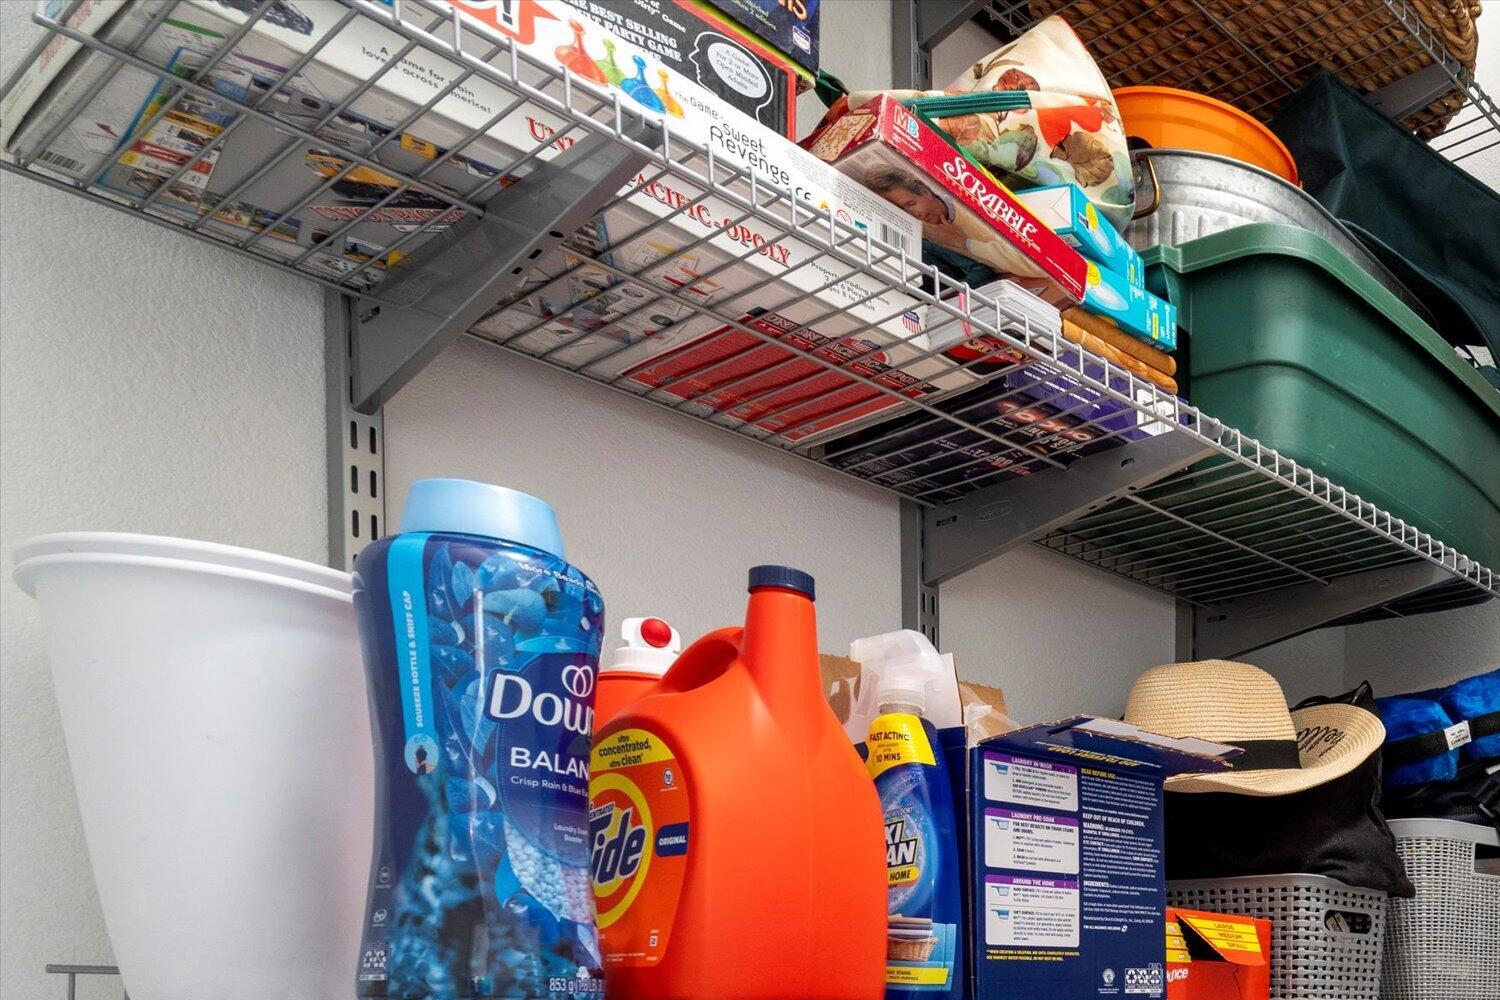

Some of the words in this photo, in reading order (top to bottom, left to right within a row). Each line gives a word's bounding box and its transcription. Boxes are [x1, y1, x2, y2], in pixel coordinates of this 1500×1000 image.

[589, 1, 623, 25] BEST
[625, 18, 678, 48] SELLING
[662, 13, 686, 33] Game
[604, 20, 646, 46] PARTY
[647, 40, 682, 62] GAME
[362, 46, 399, 70] loves
[401, 68, 439, 89] across
[380, 45, 390, 56] A
[393, 53, 426, 74] ame
[429, 66, 447, 82] for
[894, 105, 919, 138] MB
[722, 123, 768, 158] sweet
[710, 125, 791, 186] Revenge
[942, 156, 1039, 243] SCRABBLE
[628, 173, 792, 268] ACIFIC-OPOLY
[402, 590, 413, 614] CAP
[407, 615, 416, 641] SNIFF
[411, 650, 421, 681] BOTTLE
[413, 682, 424, 728] SQUEEZE
[489, 672, 594, 735] Dow
[870, 731, 883, 743] FAST
[510, 746, 589, 781] BALAN
[876, 754, 882, 763] 10
[884, 753, 901, 761] MINS
[1011, 757, 1032, 766] LAUNDRY
[1033, 760, 1053, 769] IN-WASH
[511, 775, 539, 788] Crisp
[542, 780, 561, 791] Rain
[1092, 769, 1108, 777] BEFORE
[1011, 812, 1032, 820] LAUNDRY
[1033, 814, 1056, 823] PRE-SOAK
[658, 834, 687, 846] ORIGINAL
[889, 869, 911, 881] HOME
[1213, 922, 1235, 931] LARGE
[1218, 932, 1244, 941] MEDIUM
[1226, 941, 1248, 950] SMALL
[550, 977, 569, 992] 853
[1166, 968, 1189, 983] unce
